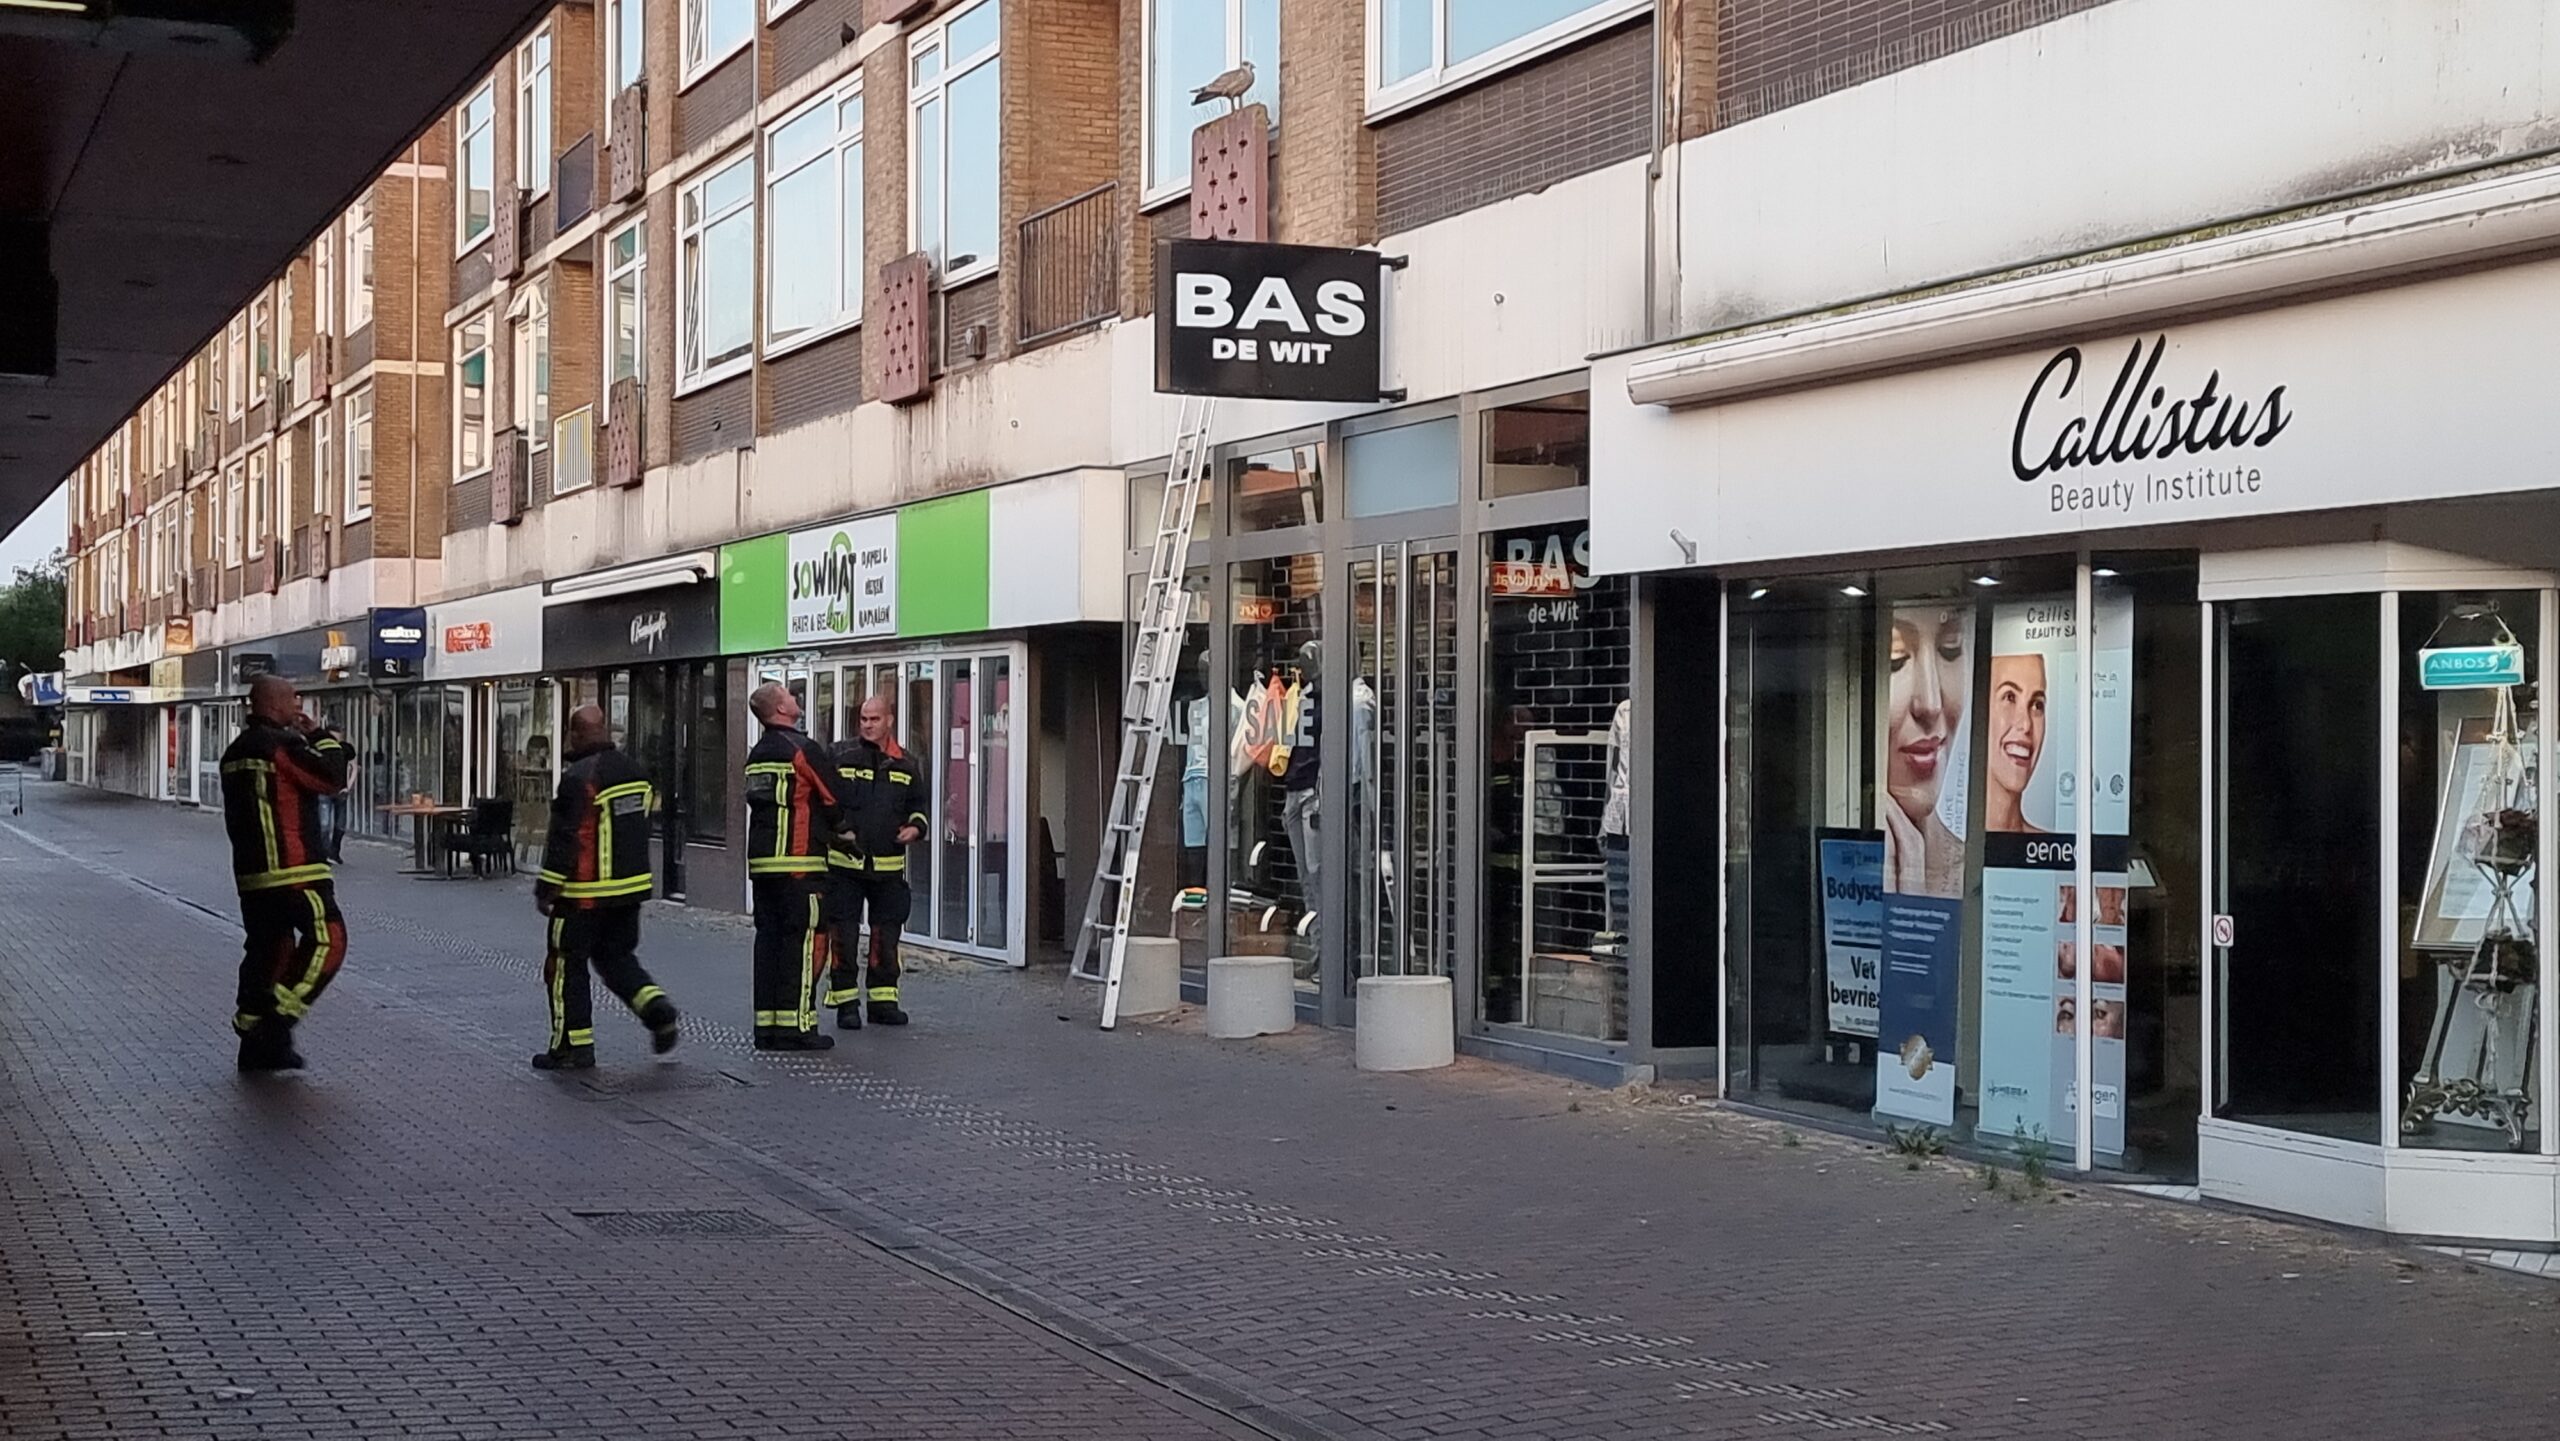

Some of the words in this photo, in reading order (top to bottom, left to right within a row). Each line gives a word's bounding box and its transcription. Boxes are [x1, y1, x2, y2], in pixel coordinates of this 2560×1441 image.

[1176, 272, 1366, 337] BAS
[1212, 337, 1258, 361] DE
[1269, 340, 1332, 364] WIT
[2012, 333, 2293, 482] Callistus
[2051, 478, 2134, 512] Beauty
[2147, 465, 2261, 504] Institute
[1528, 603, 1547, 624] de
[1551, 600, 1580, 622] Wit
[1245, 697, 1315, 747] SALE
[2025, 841, 2077, 863] gene
[1850, 956, 1877, 980] Vet
